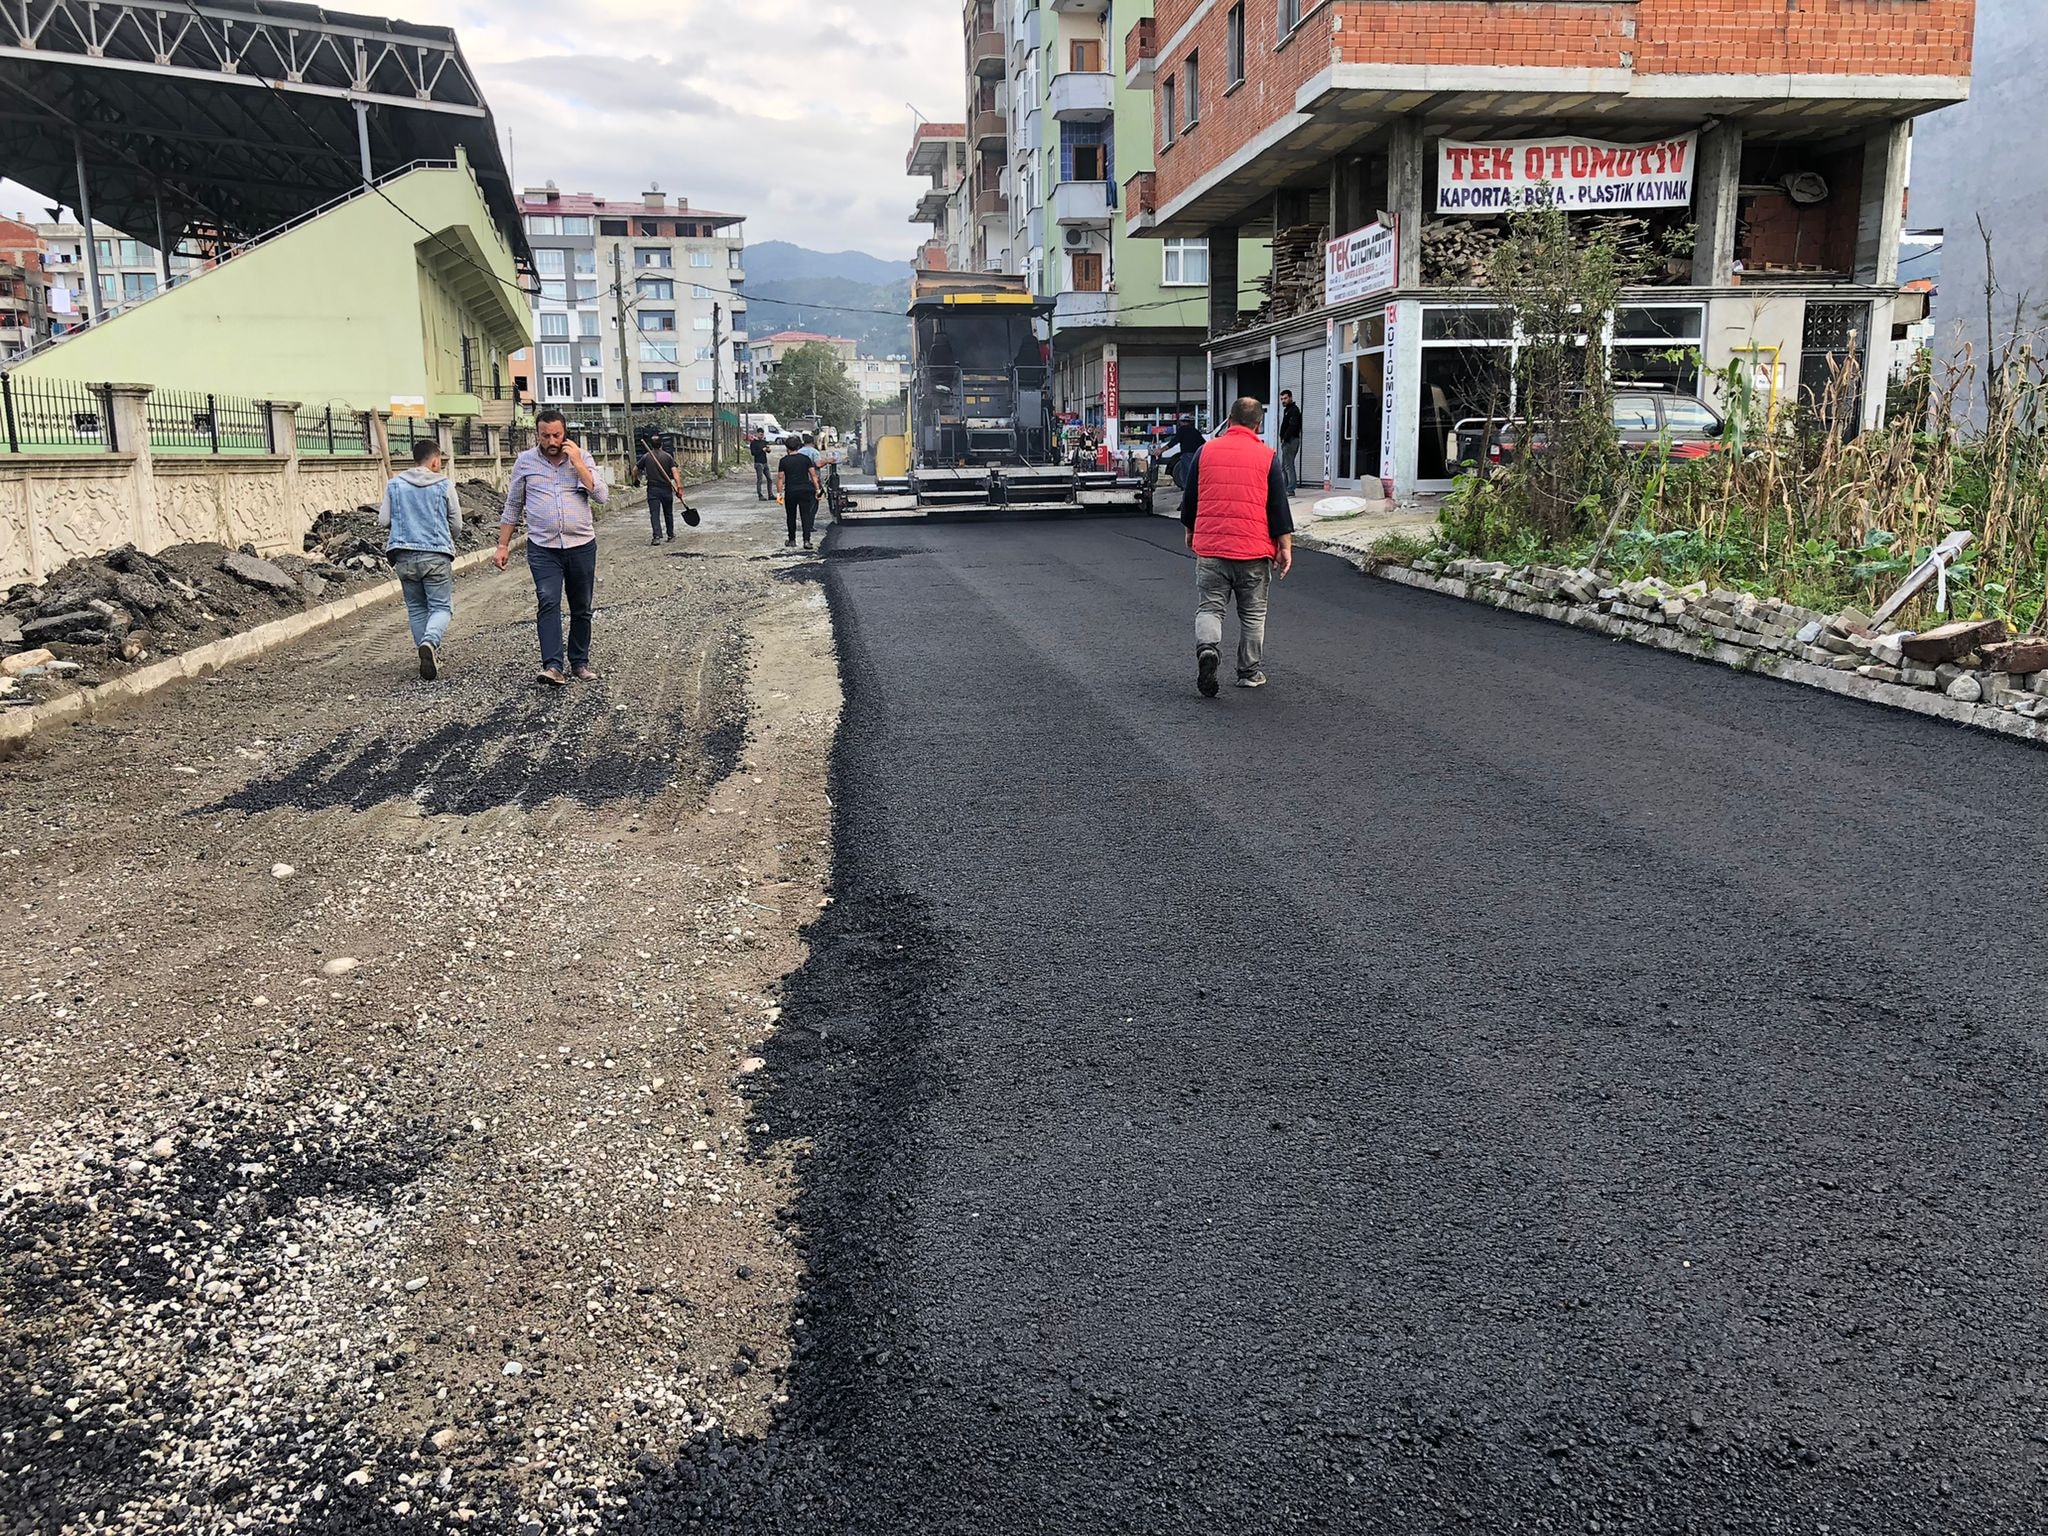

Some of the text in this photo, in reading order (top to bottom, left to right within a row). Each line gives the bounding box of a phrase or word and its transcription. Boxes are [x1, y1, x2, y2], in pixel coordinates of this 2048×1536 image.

[1446, 147, 1513, 180] TEK
[1440, 186, 1511, 207] KAPORTA
[1636, 180, 1687, 201] KAYNAK
[1329, 238, 1350, 275] TEK
[1386, 304, 1397, 324] TEK
